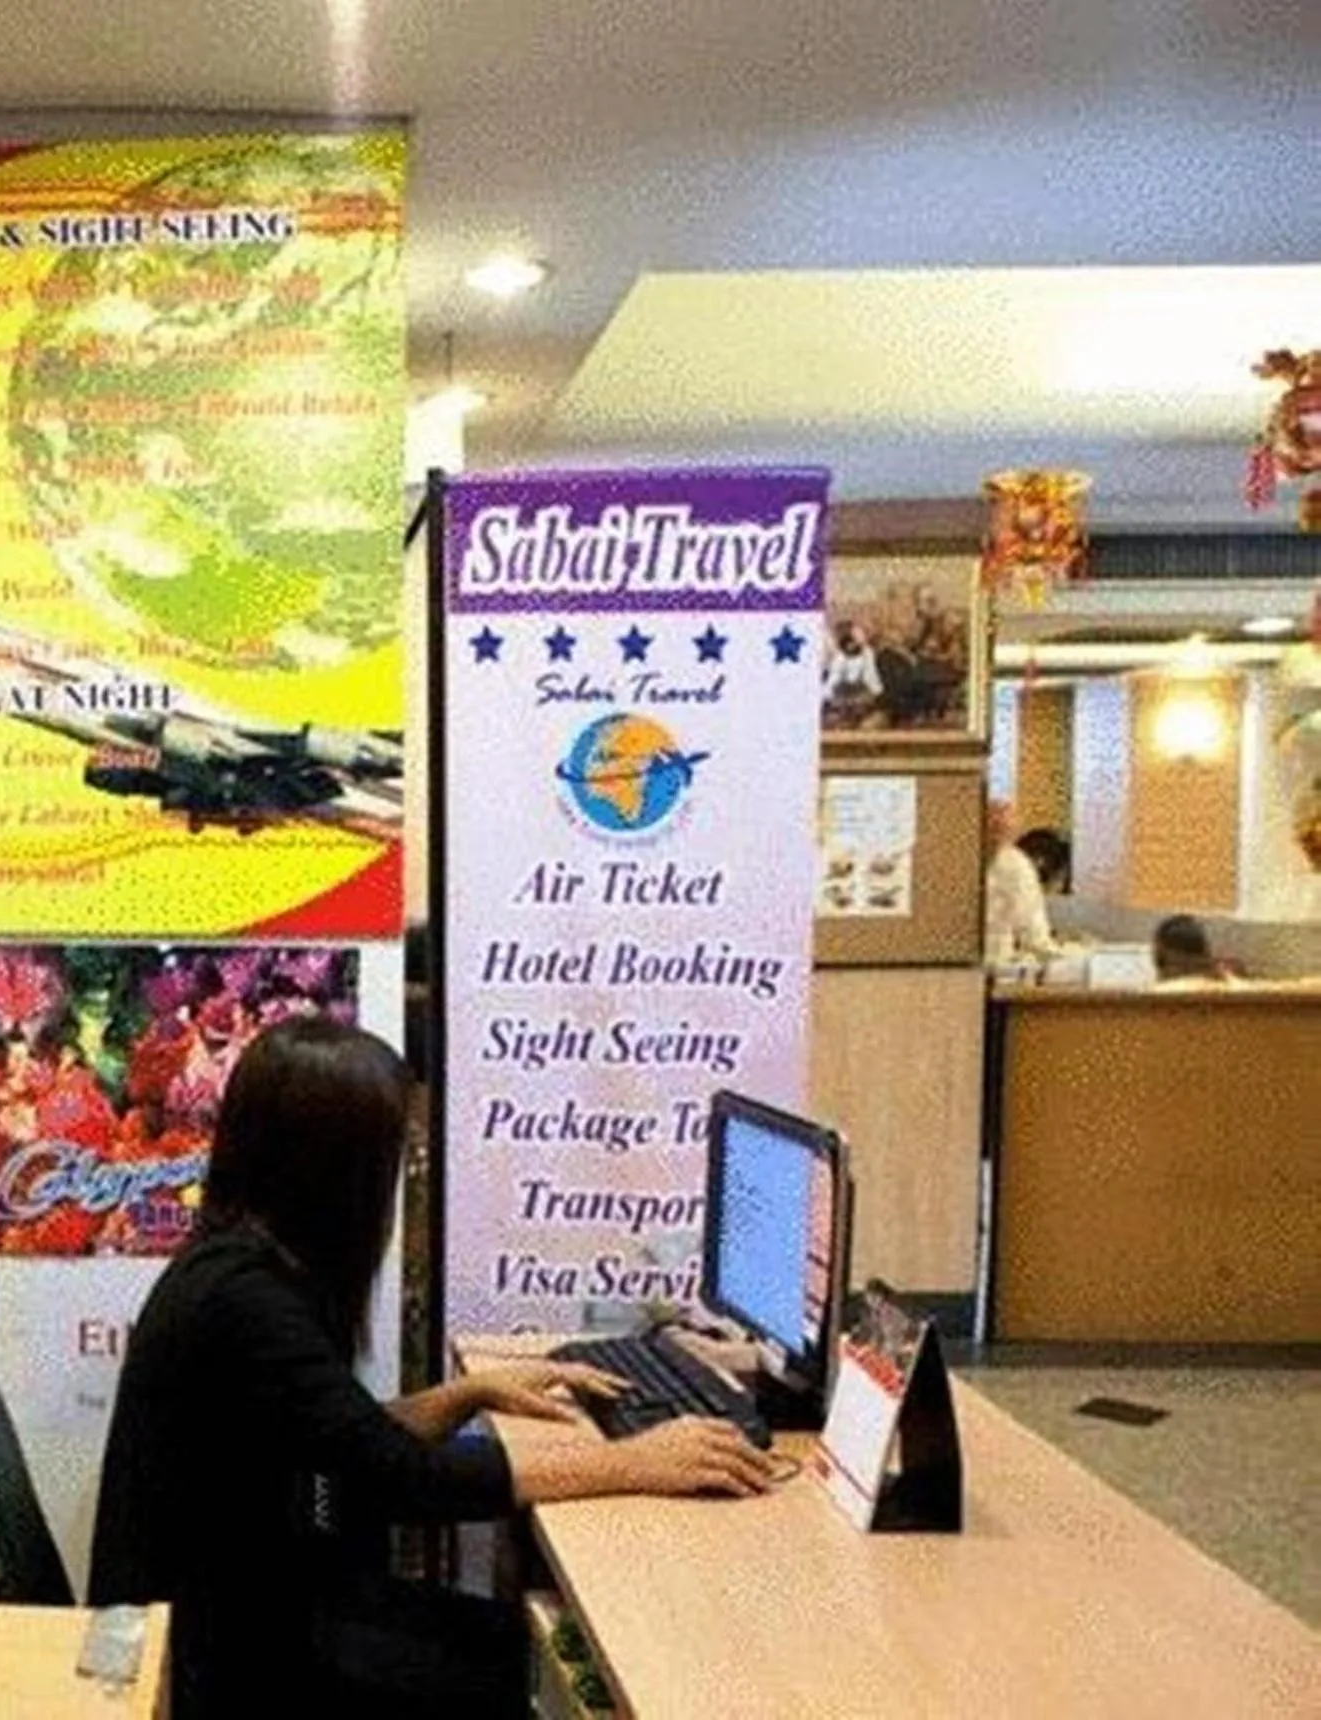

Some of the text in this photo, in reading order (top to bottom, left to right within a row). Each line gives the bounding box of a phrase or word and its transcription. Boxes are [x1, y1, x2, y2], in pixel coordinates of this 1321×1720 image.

[39, 216, 148, 246] SIGHT
[162, 210, 295, 244] SEEING
[466, 506, 816, 588] Sabai Travel
[9, 685, 46, 710] AT
[65, 683, 173, 709] NIGHT
[535, 671, 728, 706] Sabai Travel
[516, 861, 725, 904] Air Ticket
[480, 940, 784, 999] Hotel Booking
[482, 1018, 743, 1073] Sight Seeing
[482, 1097, 711, 1151] Package To
[520, 1180, 705, 1234] Transpor
[490, 1255, 698, 1302] Visa Servi
